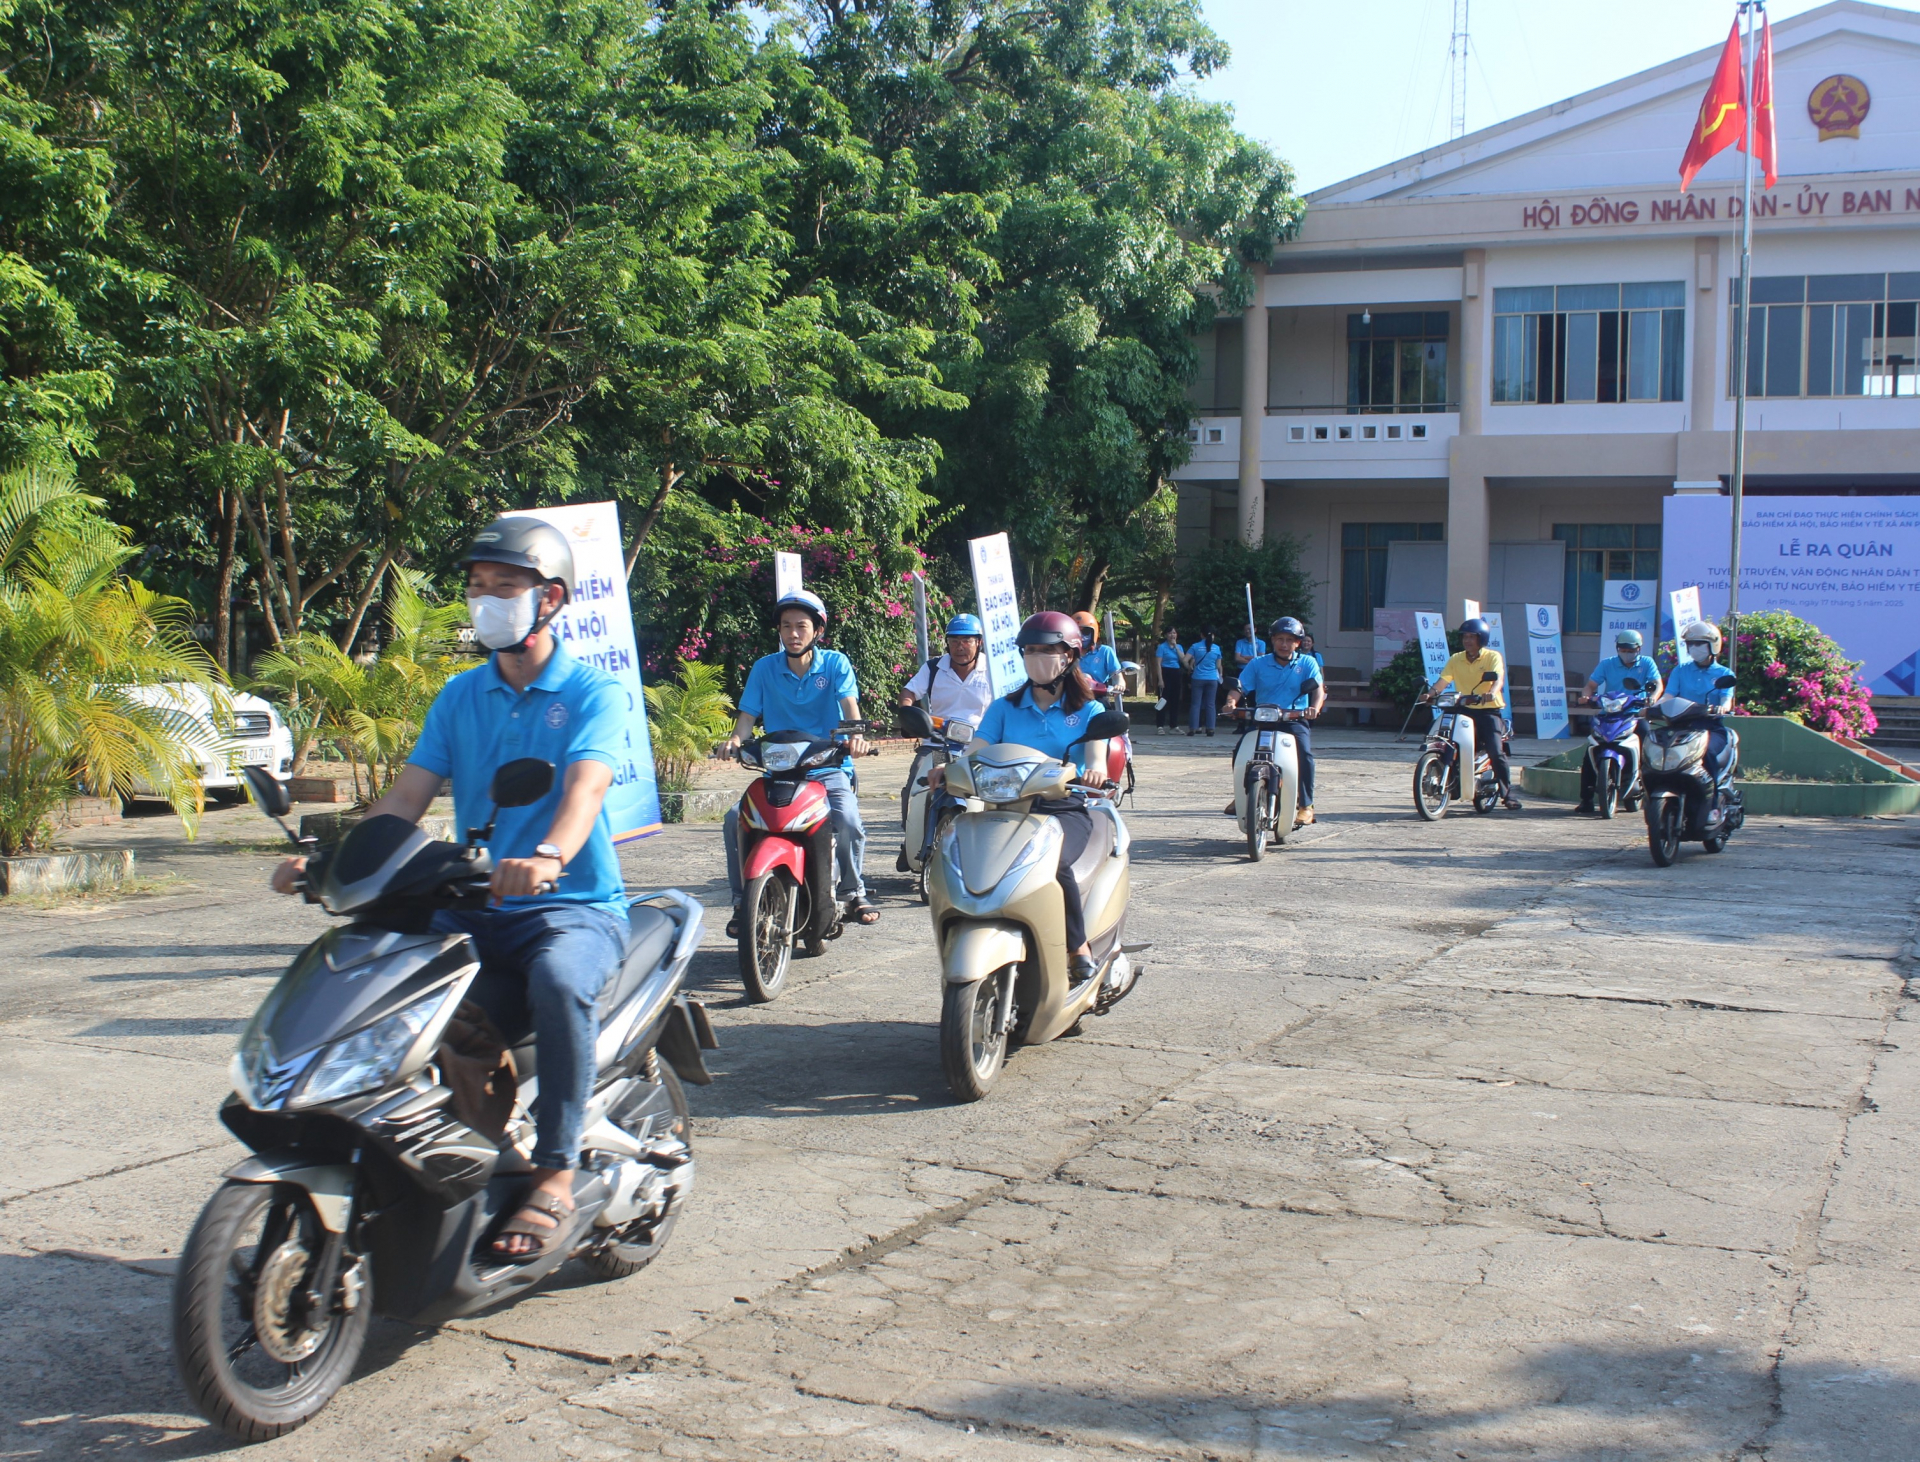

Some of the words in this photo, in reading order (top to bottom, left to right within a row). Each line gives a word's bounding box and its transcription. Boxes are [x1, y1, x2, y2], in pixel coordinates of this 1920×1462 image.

[1523, 198, 1560, 230] HỘI
[1570, 196, 1639, 225] ĐỒNG
[1651, 193, 1716, 222] NHÂN
[1842, 188, 1892, 213] BAN
[1794, 511, 1813, 519] ĐẠO
[1815, 511, 1839, 519] THỰC
[1864, 510, 1892, 518] CHÍNH
[1894, 510, 1919, 518] SÁCH
[1742, 519, 1760, 528] BẢO
[1800, 519, 1818, 529] HỘI,
[1820, 519, 1839, 528] BẢO
[1899, 520, 1912, 528] AN
[1779, 538, 1800, 556] LỄ
[1807, 544, 1832, 556] RA
[1837, 541, 1893, 558] QUÂN
[1816, 567, 1849, 578] ĐỘNG
[1851, 567, 1883, 577] NHÂN
[1886, 567, 1911, 577] DÂN
[1753, 581, 1772, 591] HỘI
[1775, 582, 1790, 592] TỰ
[1791, 581, 1839, 592] NGUYỆN,
[1841, 581, 1865, 591] BẢO
[1799, 599, 1818, 607] ngày
[1830, 599, 1855, 607] tháng
[577, 610, 607, 643] HỘI
[1609, 619, 1625, 629] BẢO
